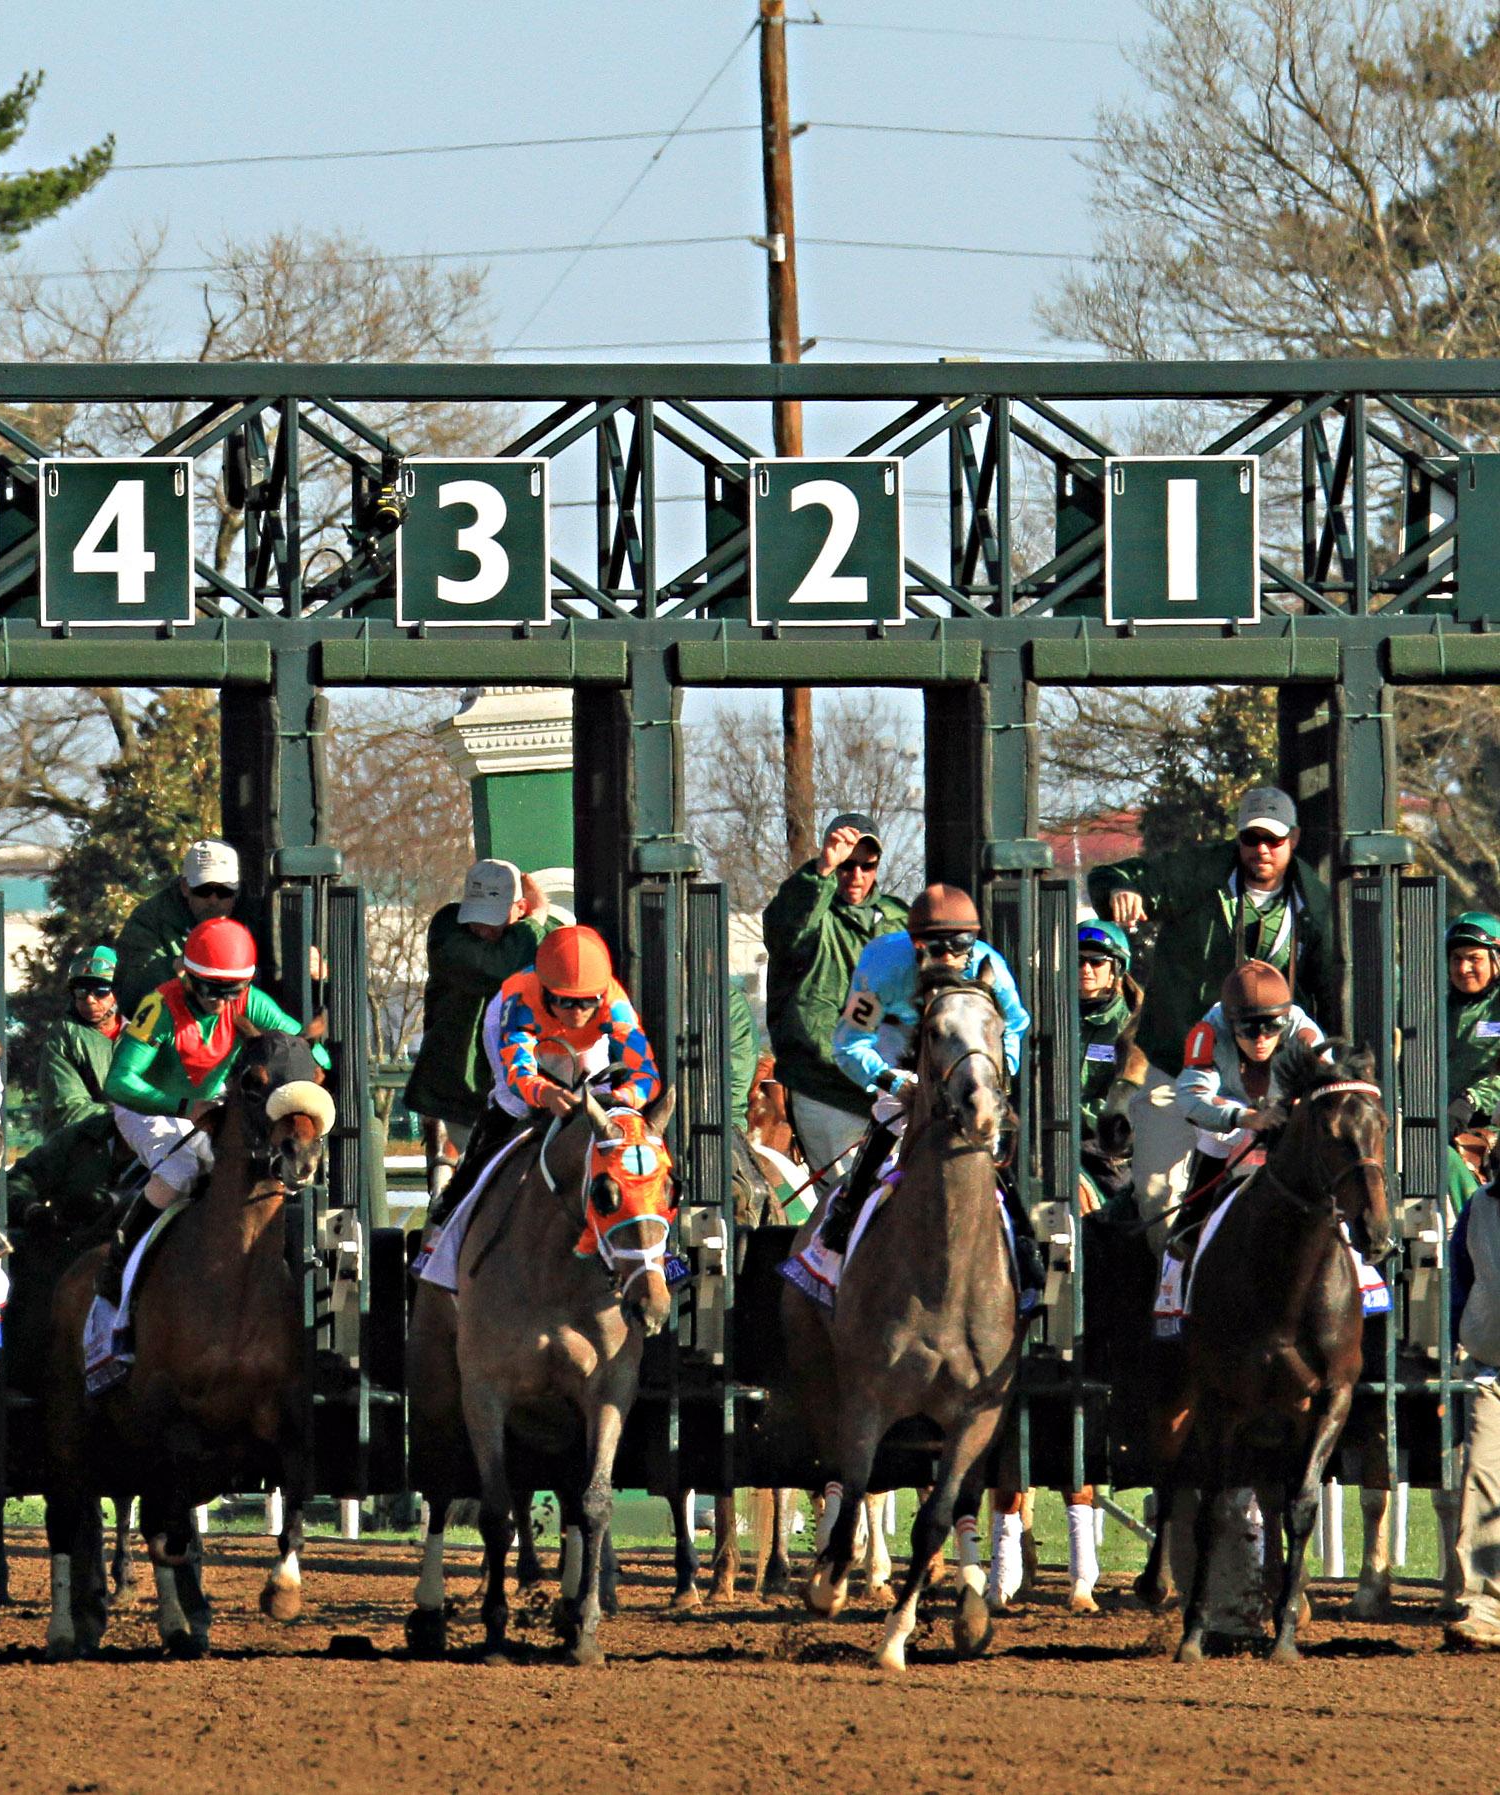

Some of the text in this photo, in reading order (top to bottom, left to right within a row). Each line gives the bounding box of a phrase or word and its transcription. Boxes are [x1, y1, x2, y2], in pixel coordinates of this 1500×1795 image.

[73, 480, 155, 604] 4
[437, 480, 510, 604] 3
[789, 480, 868, 604] 2
[1168, 479, 1198, 601] 1
[136, 1003, 155, 1028] 4
[501, 1000, 513, 1027] 3
[852, 998, 874, 1026] 2
[1192, 1031, 1204, 1058] 1
[665, 1260, 686, 1280] ER
